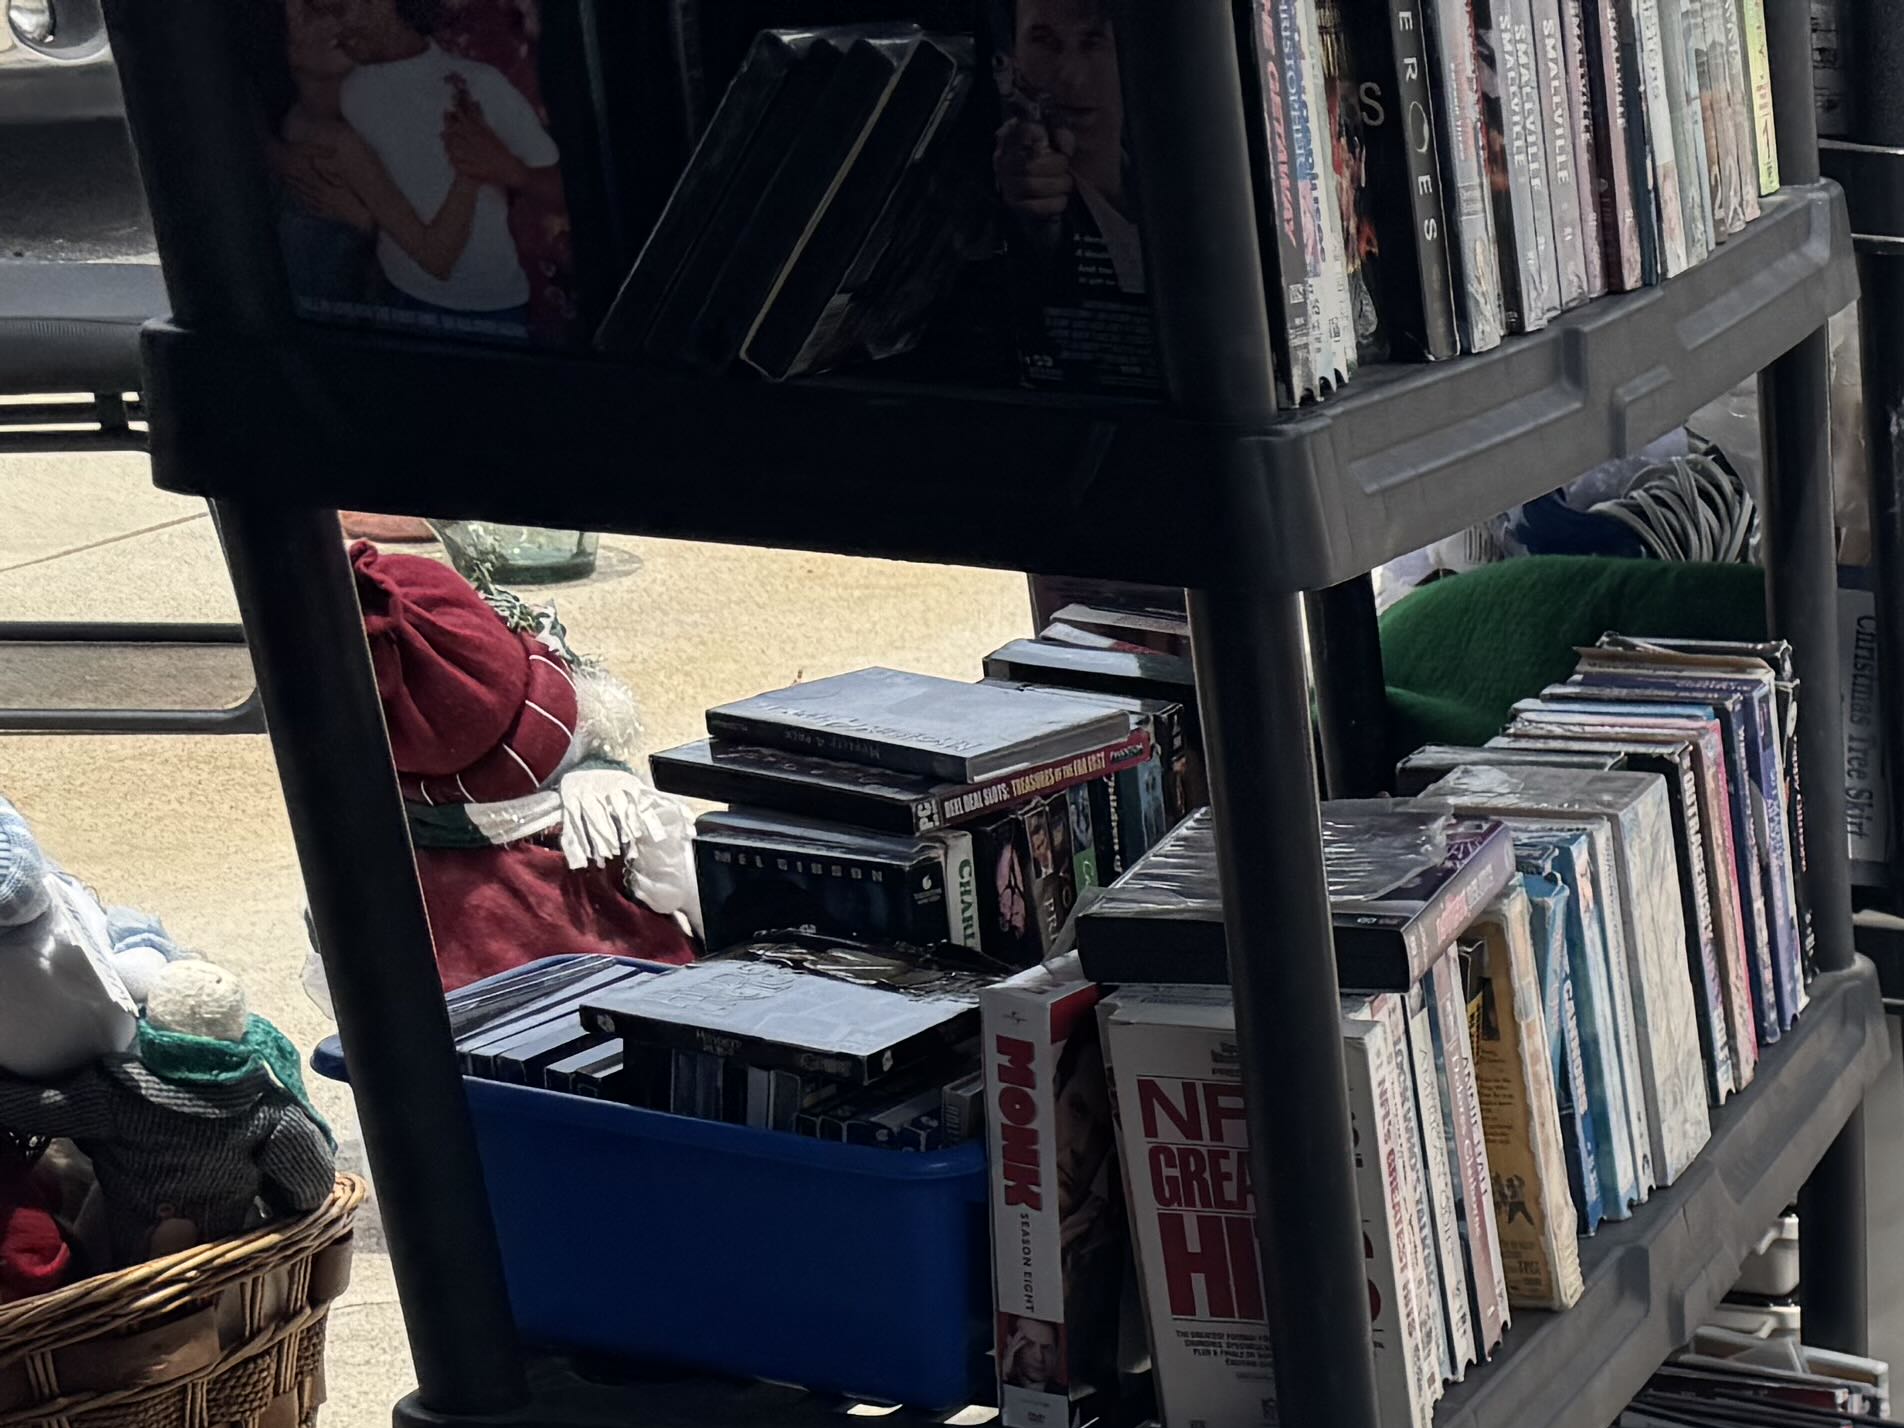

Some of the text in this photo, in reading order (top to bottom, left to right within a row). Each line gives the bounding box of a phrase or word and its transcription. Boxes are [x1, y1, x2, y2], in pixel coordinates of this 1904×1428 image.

[1399, 0, 1438, 243] EROES
[1542, 18, 1568, 185] SMALLVILLE
[996, 1034, 1043, 1212] MONK
[1136, 1078, 1248, 1146] NF
[1148, 1144, 1258, 1210] GREA
[1019, 1213, 1035, 1314] SEASON EIGHT
[1156, 1209, 1268, 1321] HI
